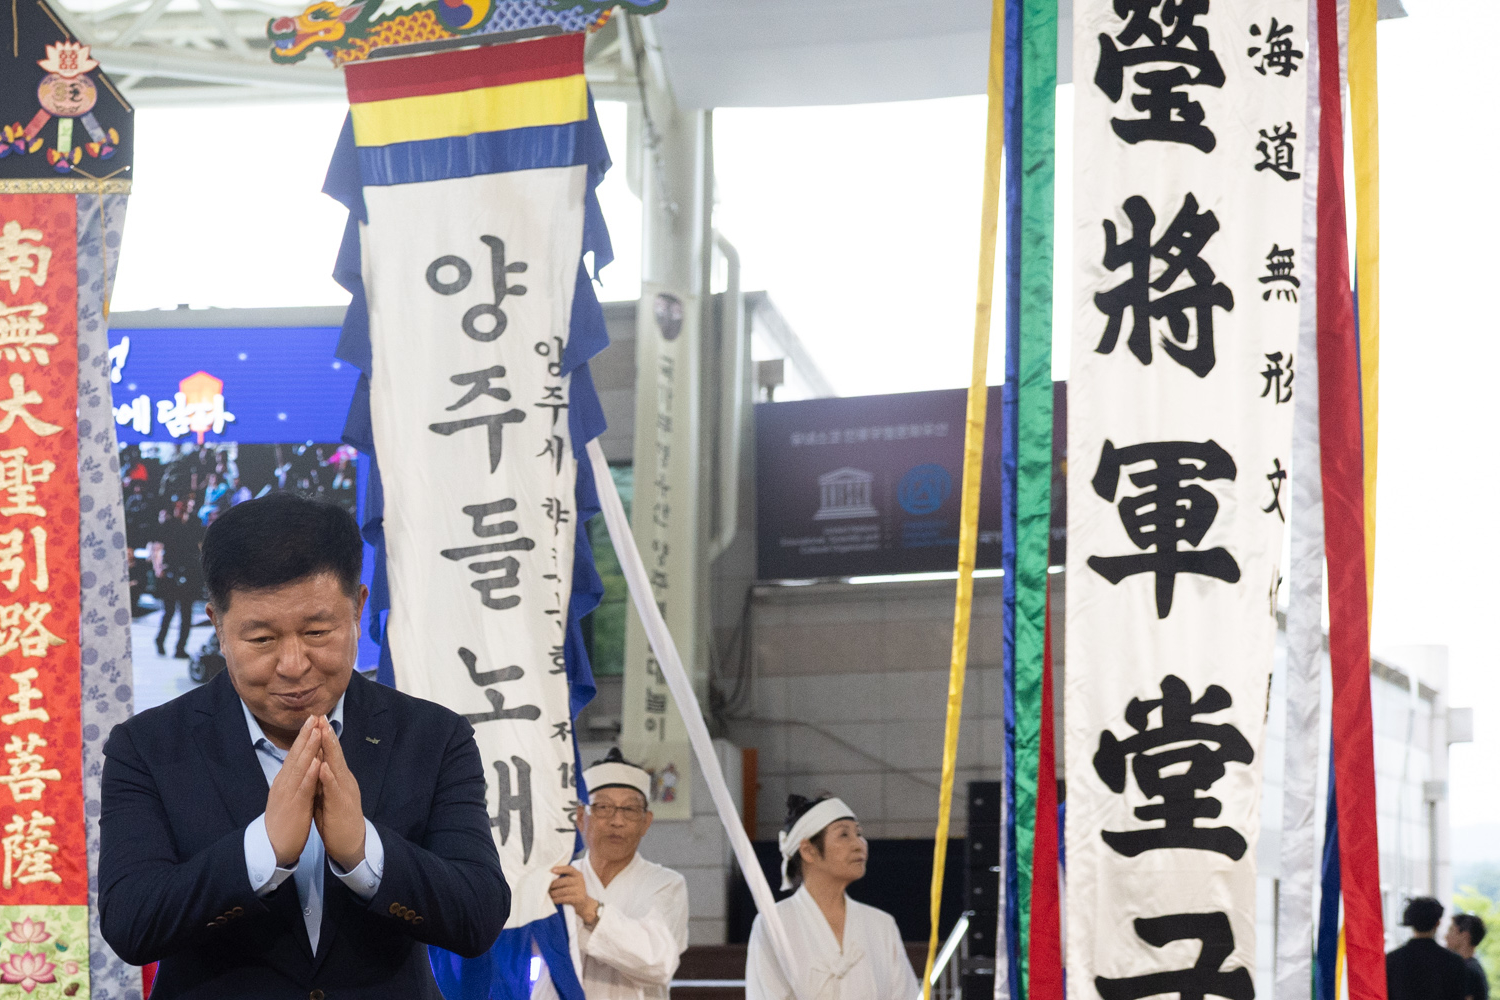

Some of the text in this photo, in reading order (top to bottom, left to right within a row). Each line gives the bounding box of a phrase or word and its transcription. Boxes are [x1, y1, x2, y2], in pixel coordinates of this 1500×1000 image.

[425, 234, 541, 866] 양주들노래
[1247, 17, 1303, 724] 海道無形文
